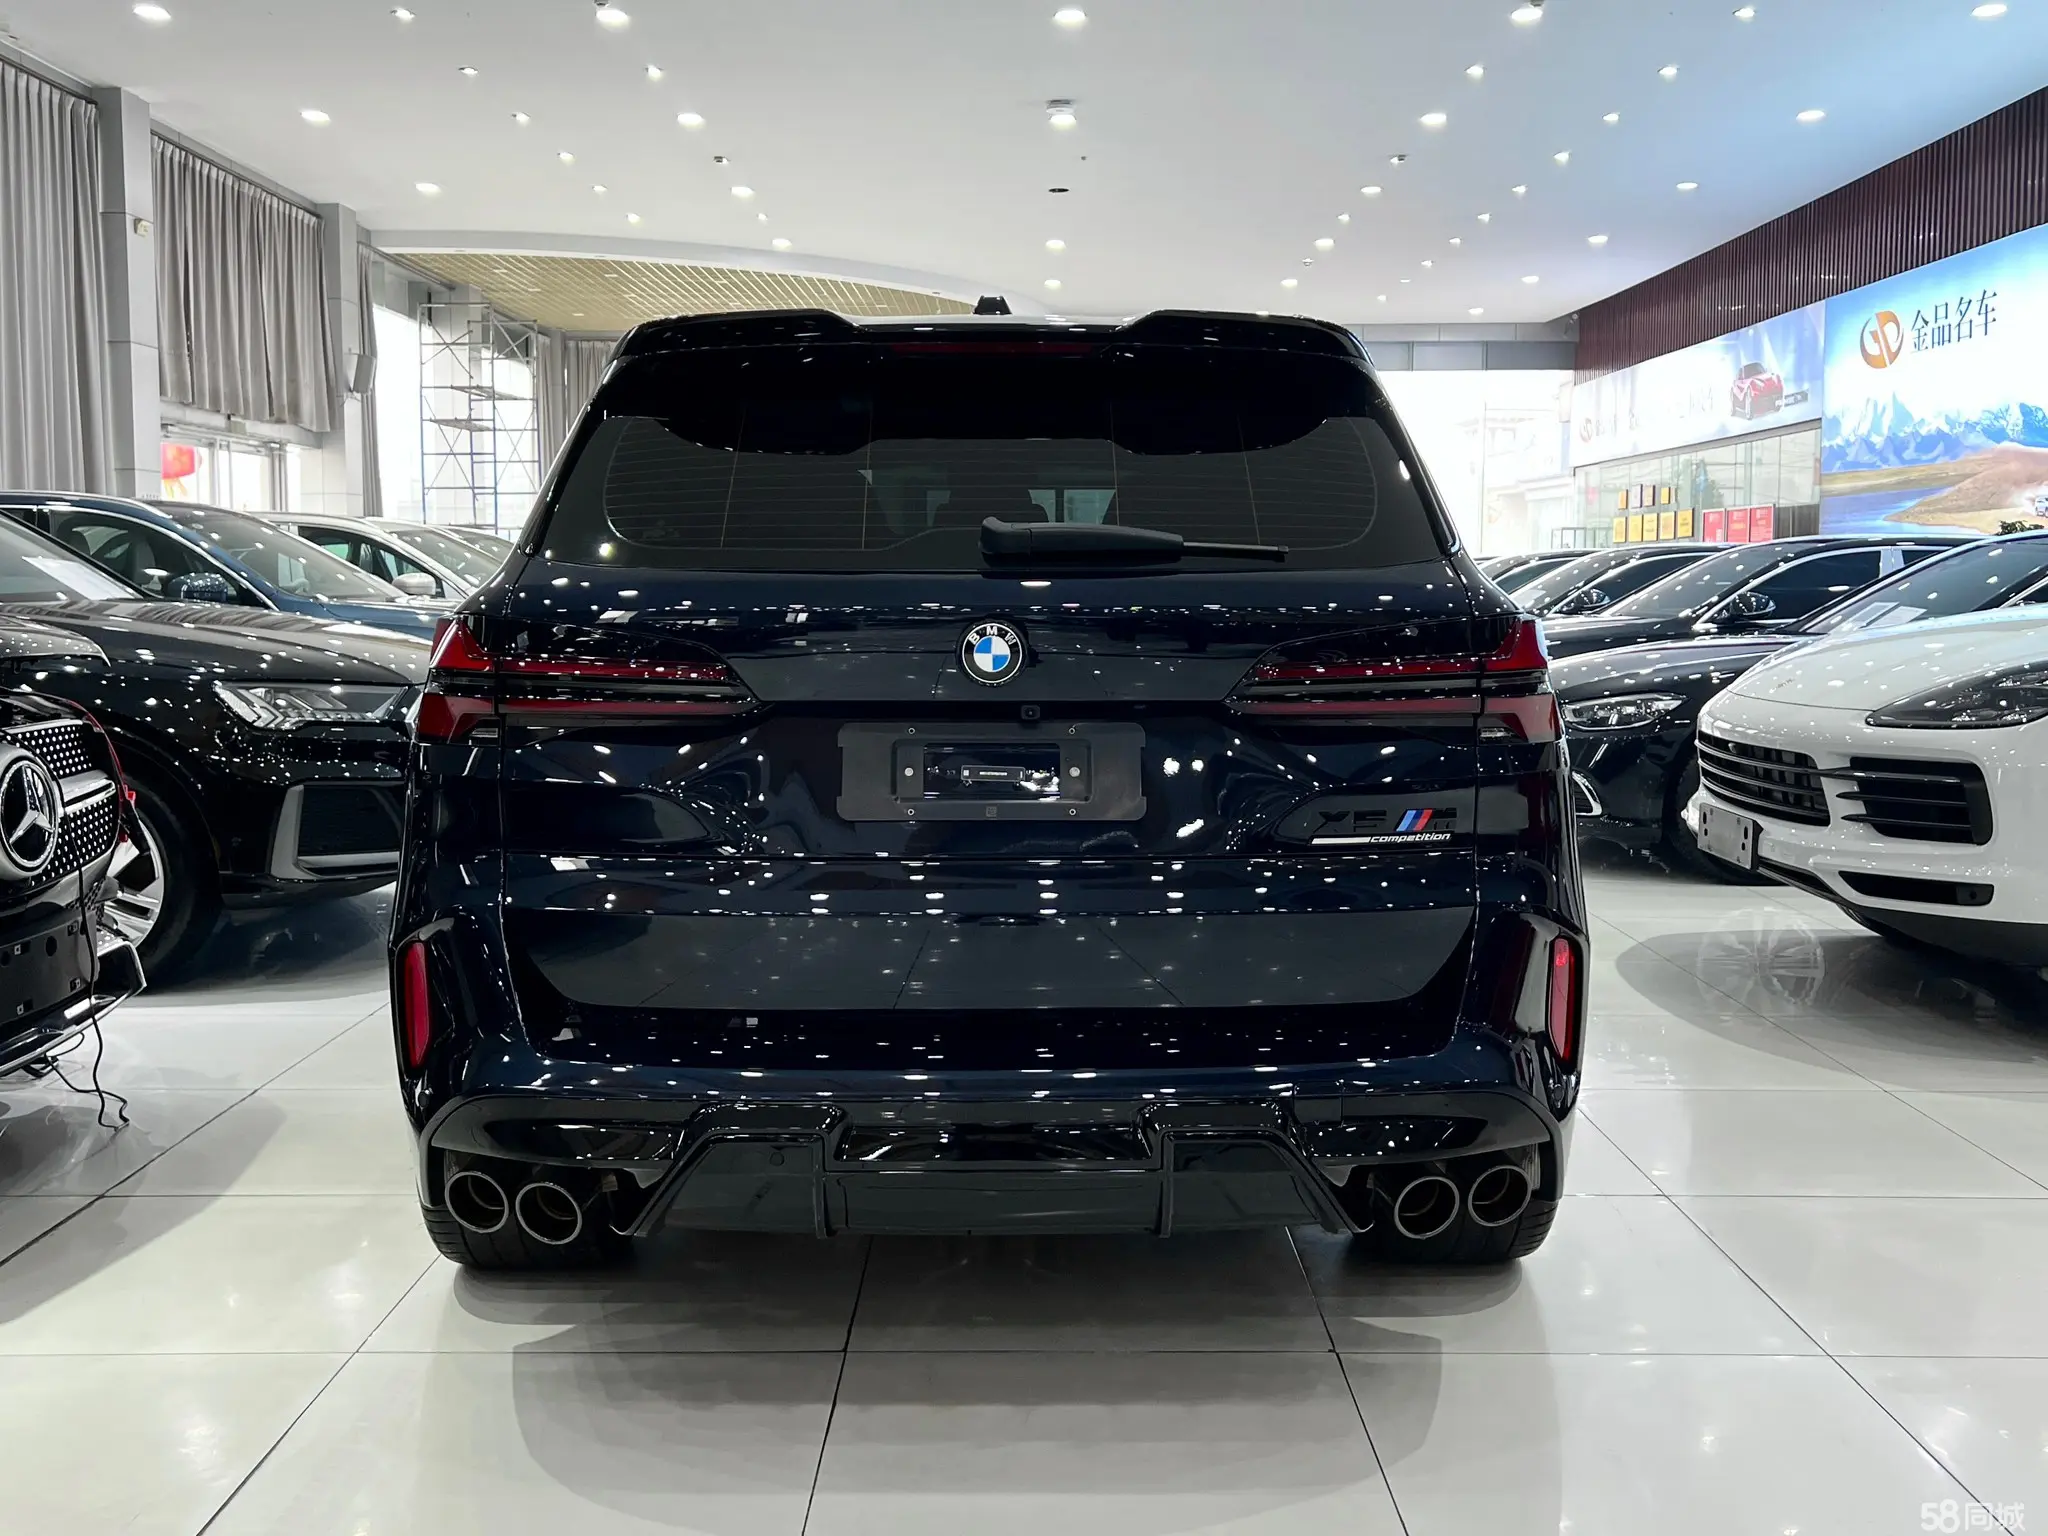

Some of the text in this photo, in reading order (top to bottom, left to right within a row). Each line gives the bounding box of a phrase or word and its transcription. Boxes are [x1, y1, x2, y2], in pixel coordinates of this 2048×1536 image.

[1910, 289, 1998, 354] 金品名车
[968, 625, 1017, 646] BMW
[1313, 809, 1388, 833] X5
[1370, 832, 1452, 844] competition
